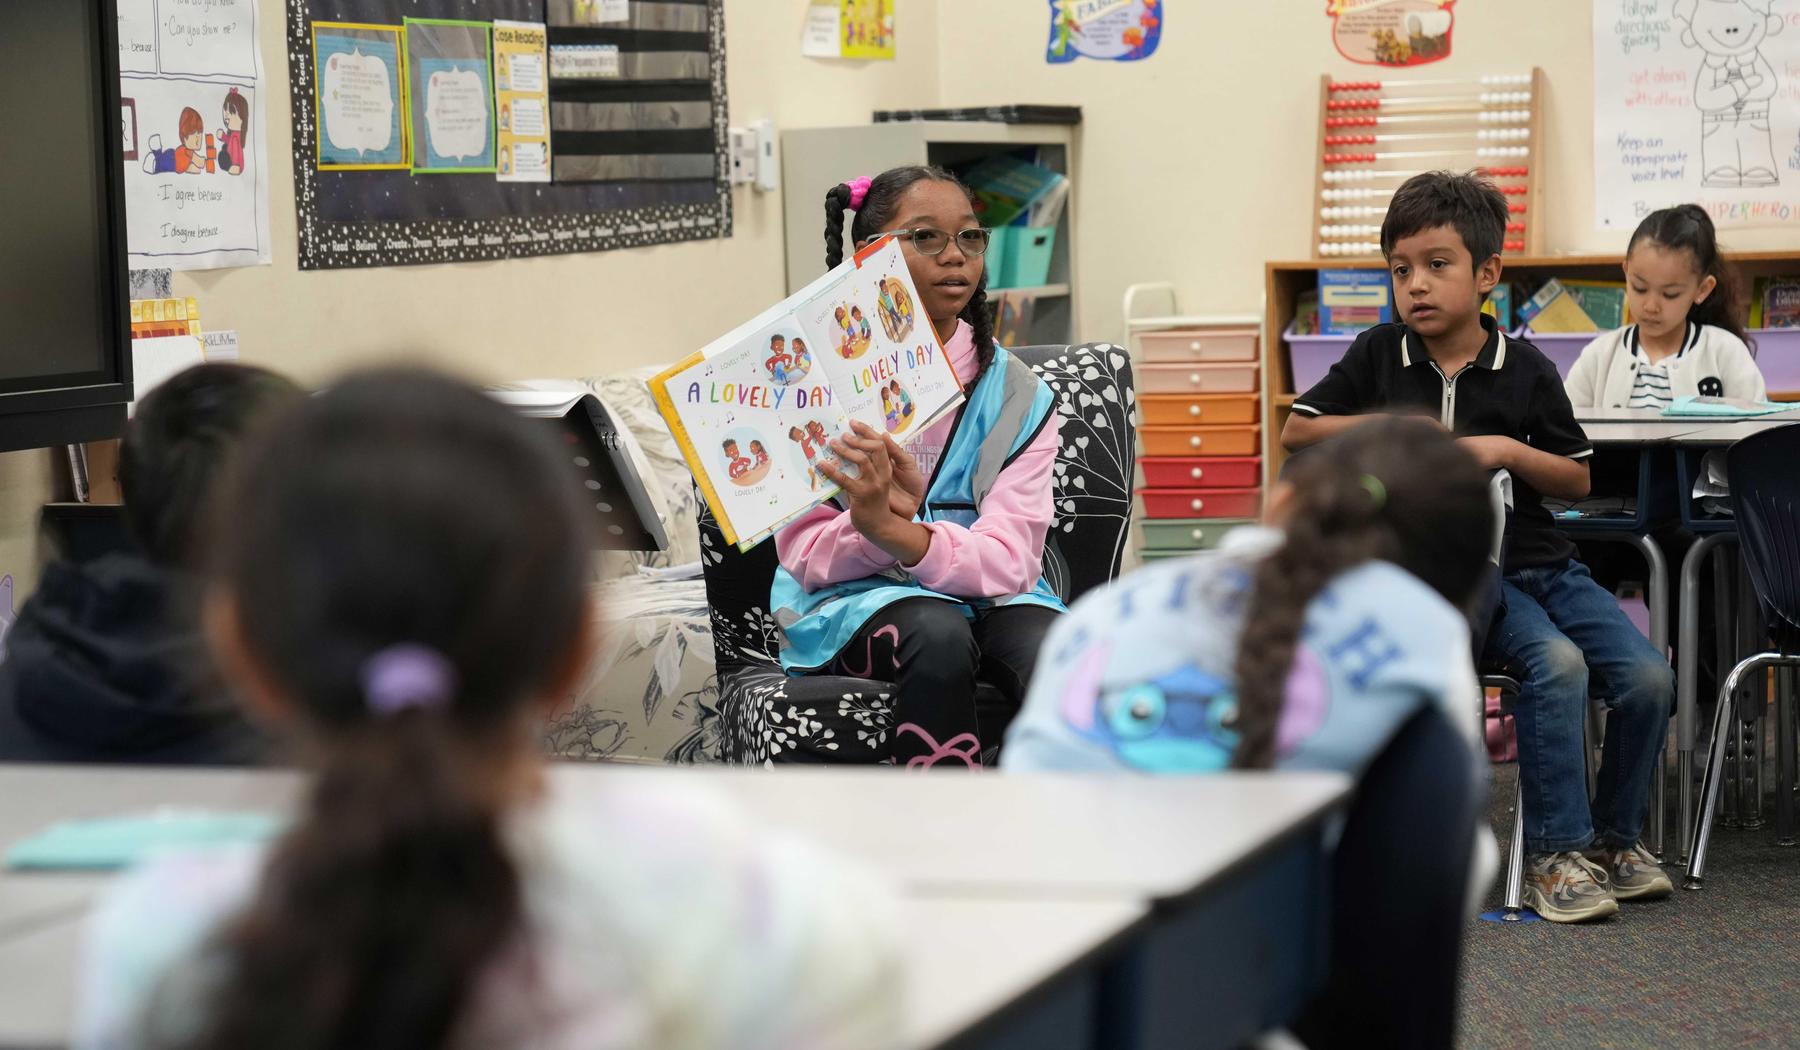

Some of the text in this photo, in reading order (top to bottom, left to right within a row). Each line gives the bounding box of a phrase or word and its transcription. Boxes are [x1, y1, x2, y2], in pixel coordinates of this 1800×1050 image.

[168, 15, 185, 36] Can
[186, 26, 201, 47] you
[1614, 19, 1671, 35] directions
[514, 30, 545, 49] Reading
[301, 99, 310, 146] Explore
[1660, 167, 1684, 180] level
[159, 184, 223, 210] I agree because
[160, 222, 218, 244] I disagree because
[305, 215, 314, 258] Create
[332, 240, 349, 252] Read
[355, 239, 378, 252] Believe
[386, 239, 408, 250] Create
[413, 237, 433, 248] Dream
[436, 236, 459, 249] Explore
[463, 234, 479, 246] Read
[552, 229, 574, 241] Explore
[853, 343, 933, 394] LOVELY DAY
[688, 381, 832, 410] A LOVELY DAY
[735, 487, 755, 497] LOVELY
